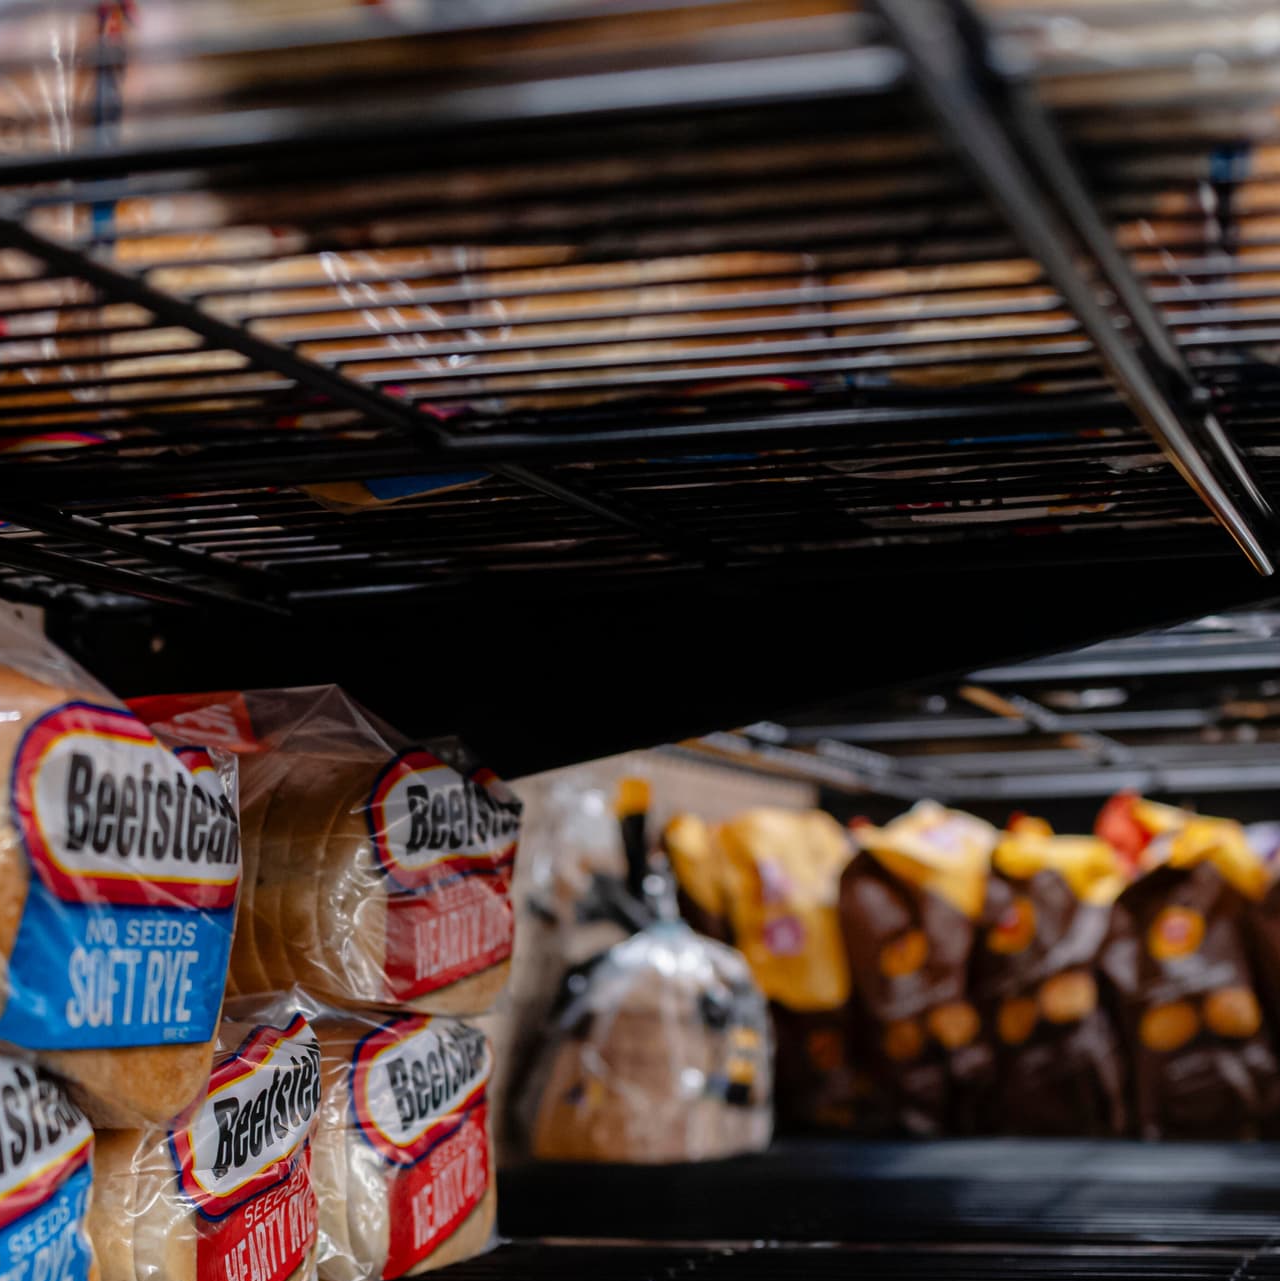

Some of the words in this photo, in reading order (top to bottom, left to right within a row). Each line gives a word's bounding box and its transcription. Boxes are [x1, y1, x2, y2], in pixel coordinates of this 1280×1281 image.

[86, 920, 118, 947] NO
[124, 921, 198, 947] SEEDS
[65, 947, 142, 1029] SOFT
[141, 950, 199, 1025] RYE
[212, 1040, 321, 1181] Beefstea
[8, 1197, 72, 1263] SEEDS
[243, 1169, 305, 1229] SEEDED
